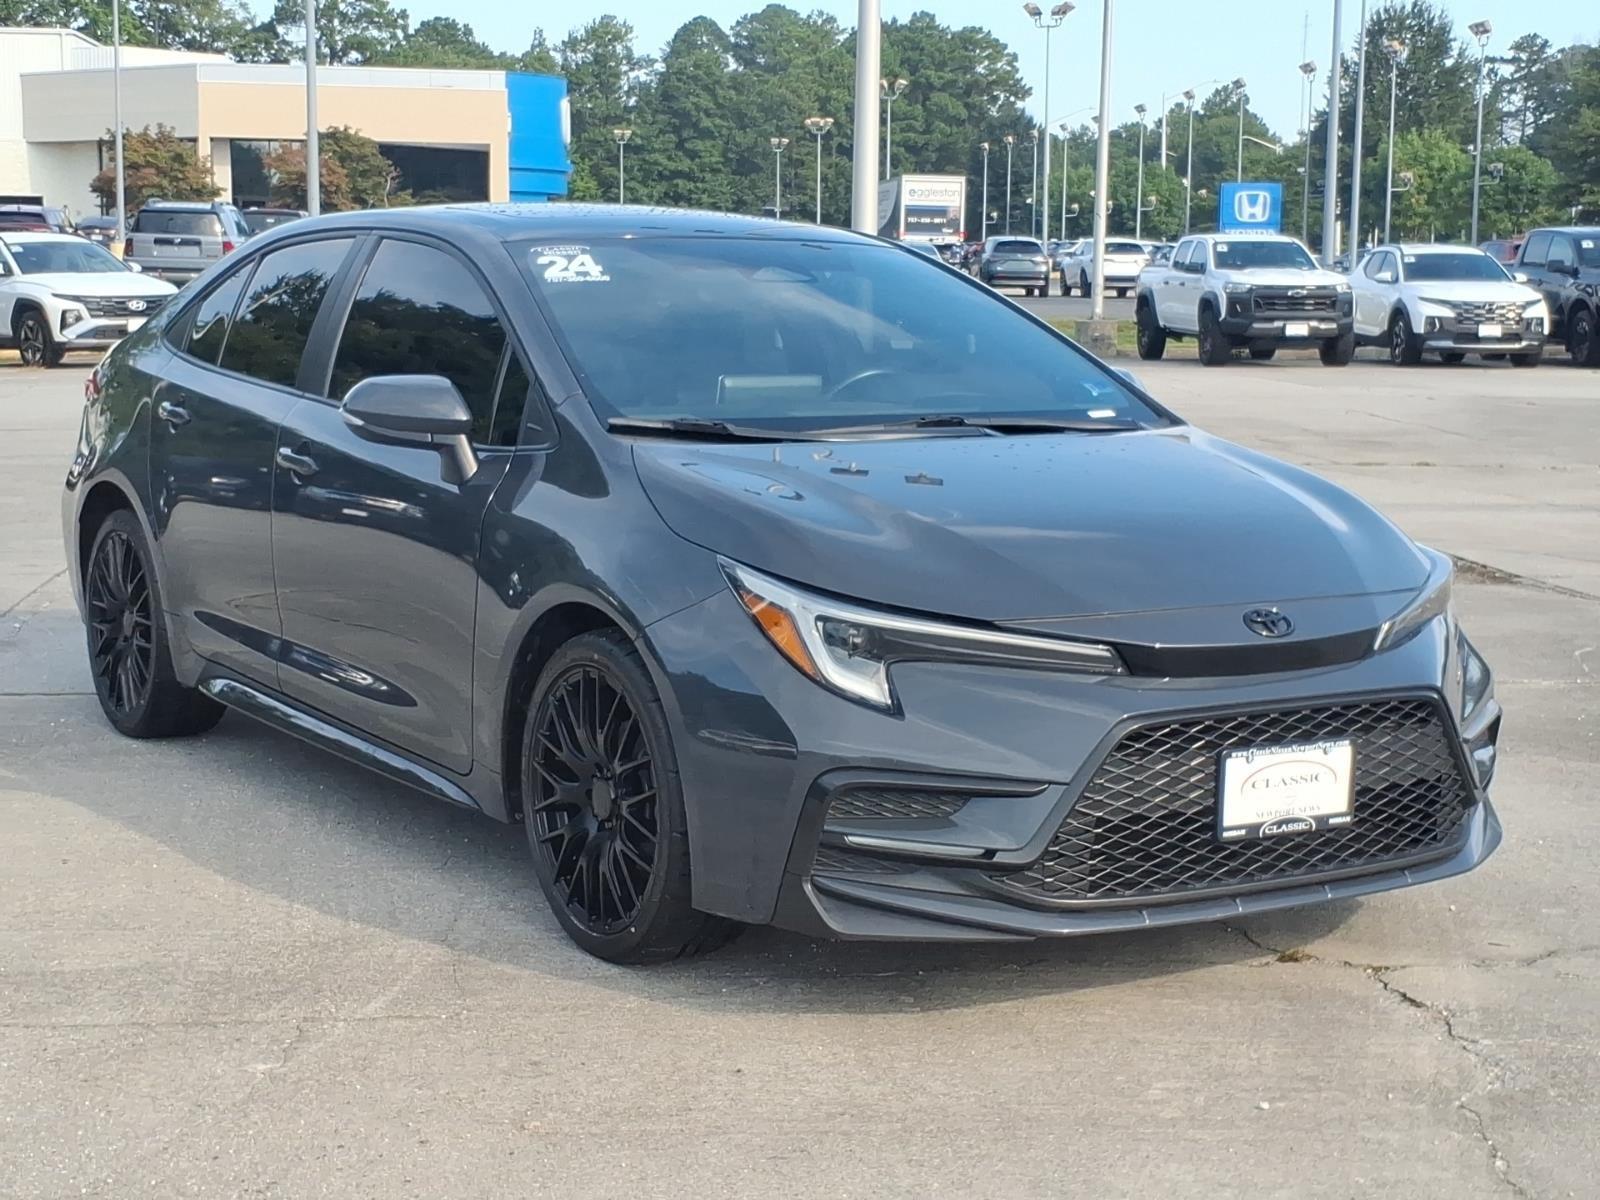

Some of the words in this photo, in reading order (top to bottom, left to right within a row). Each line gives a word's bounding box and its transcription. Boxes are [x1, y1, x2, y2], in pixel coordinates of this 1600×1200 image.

[908, 187, 960, 198] eggleston
[537, 254, 603, 279] 24
[1251, 773, 1321, 790] CLASSIC
[1264, 821, 1310, 834] CLASSIC
